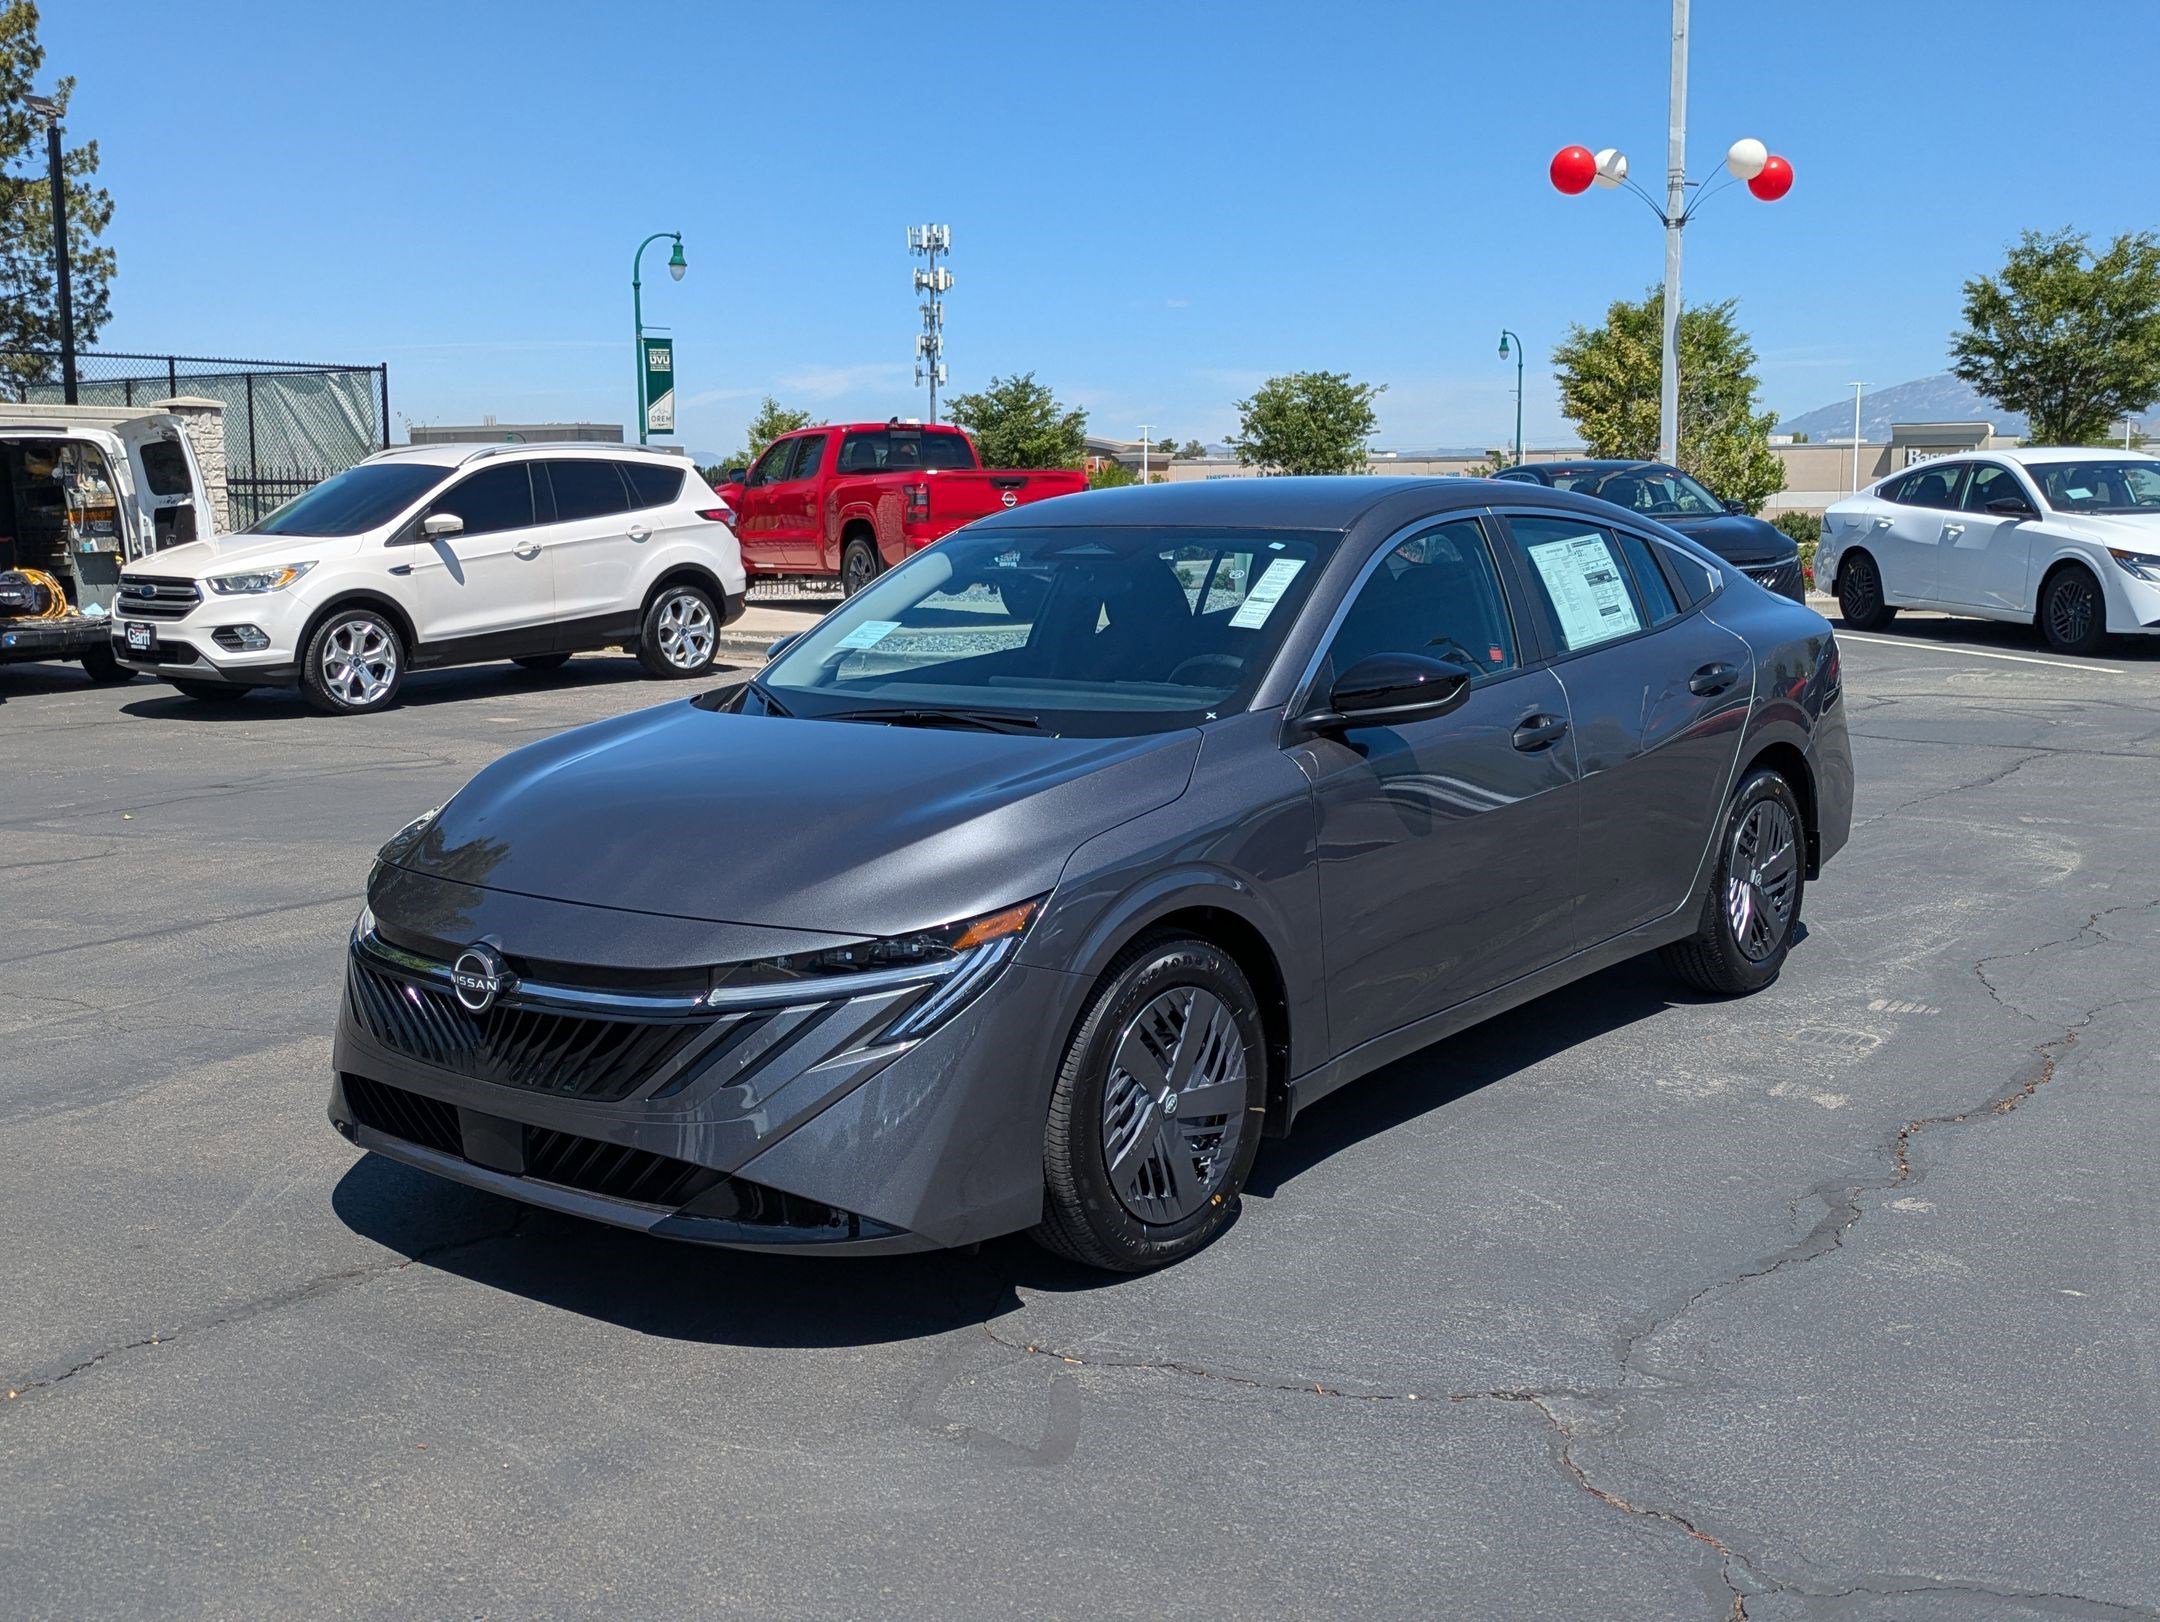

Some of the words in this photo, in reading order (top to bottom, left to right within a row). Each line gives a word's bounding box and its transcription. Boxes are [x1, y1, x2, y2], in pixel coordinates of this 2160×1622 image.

[649, 355, 670, 365] UVU
[651, 415, 672, 423] OREM
[450, 972, 497, 991] NISSAN
